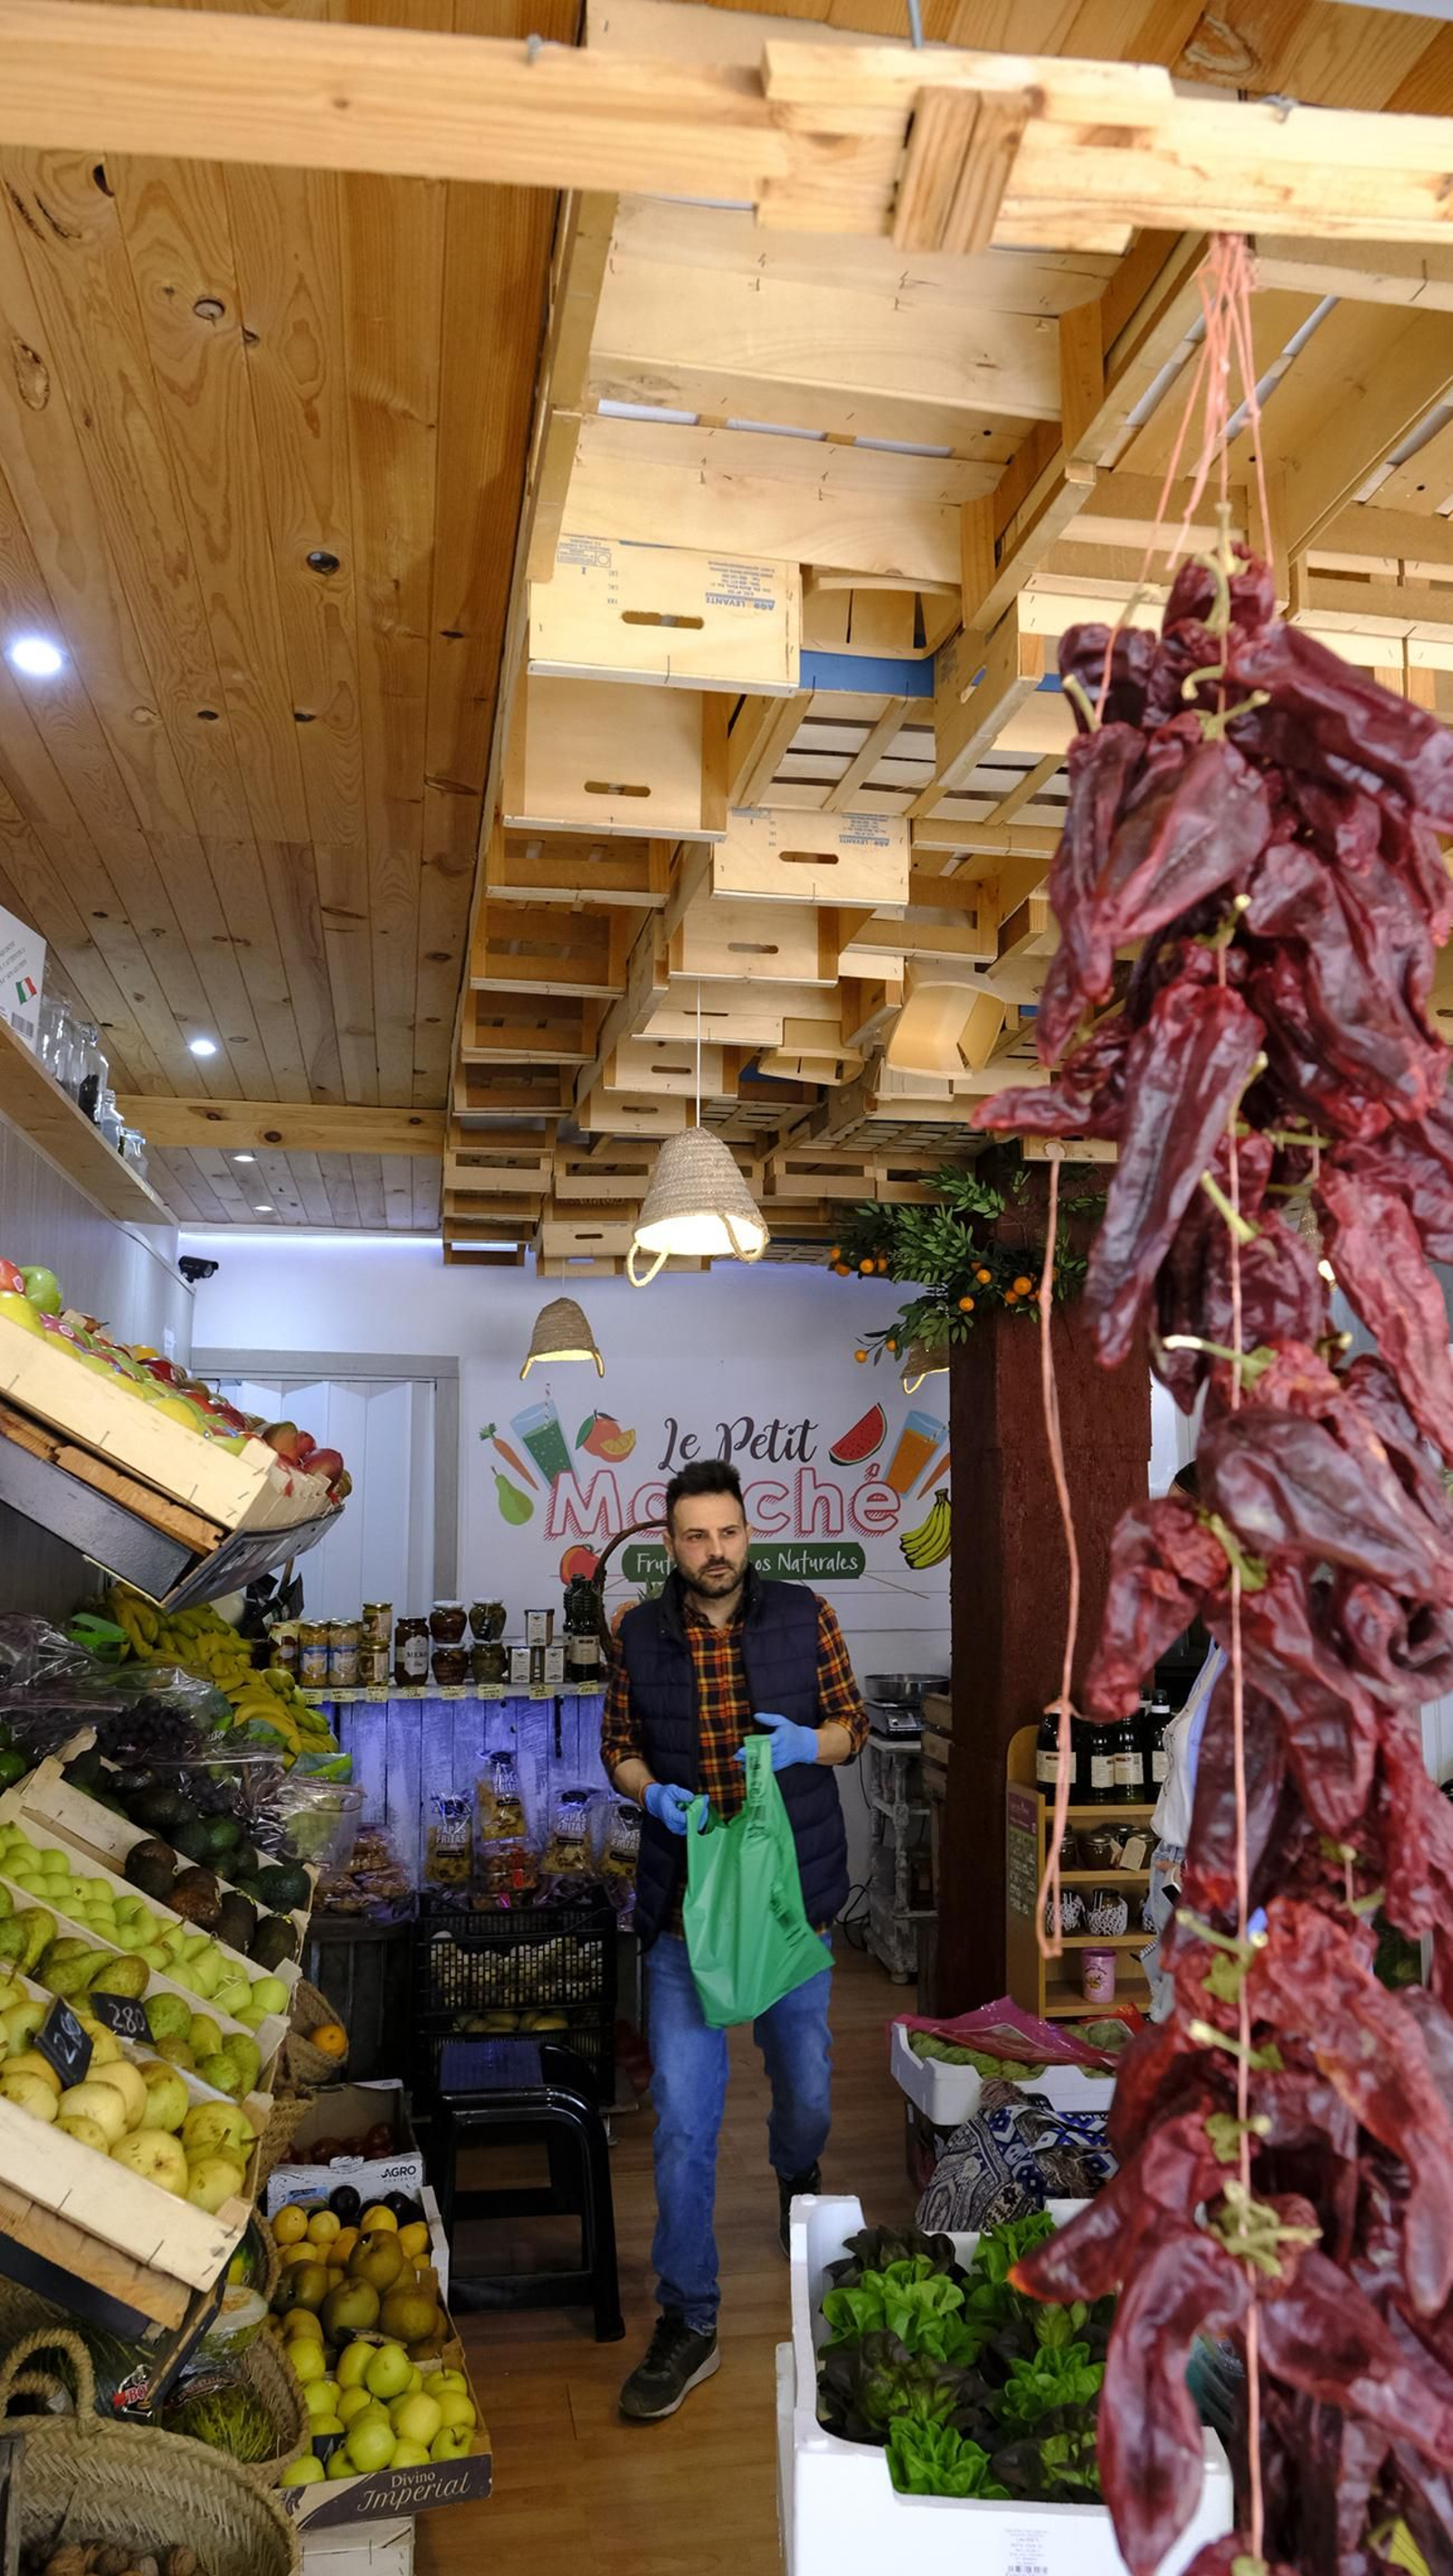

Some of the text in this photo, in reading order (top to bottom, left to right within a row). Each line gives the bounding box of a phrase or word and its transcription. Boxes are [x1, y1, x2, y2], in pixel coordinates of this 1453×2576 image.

[657, 1416, 818, 1472] Le Petit
[543, 1462, 902, 1539] Maché
[777, 1549, 859, 1574] Naturales
[557, 1821, 587, 1831] FRITAS
[558, 1813, 587, 1823] PAPAS
[436, 1834, 465, 1843] FRITAS
[381, 2166, 417, 2178] AGRO
[391, 2471, 436, 2488] Divino
[357, 2472, 471, 2512] Imperial
